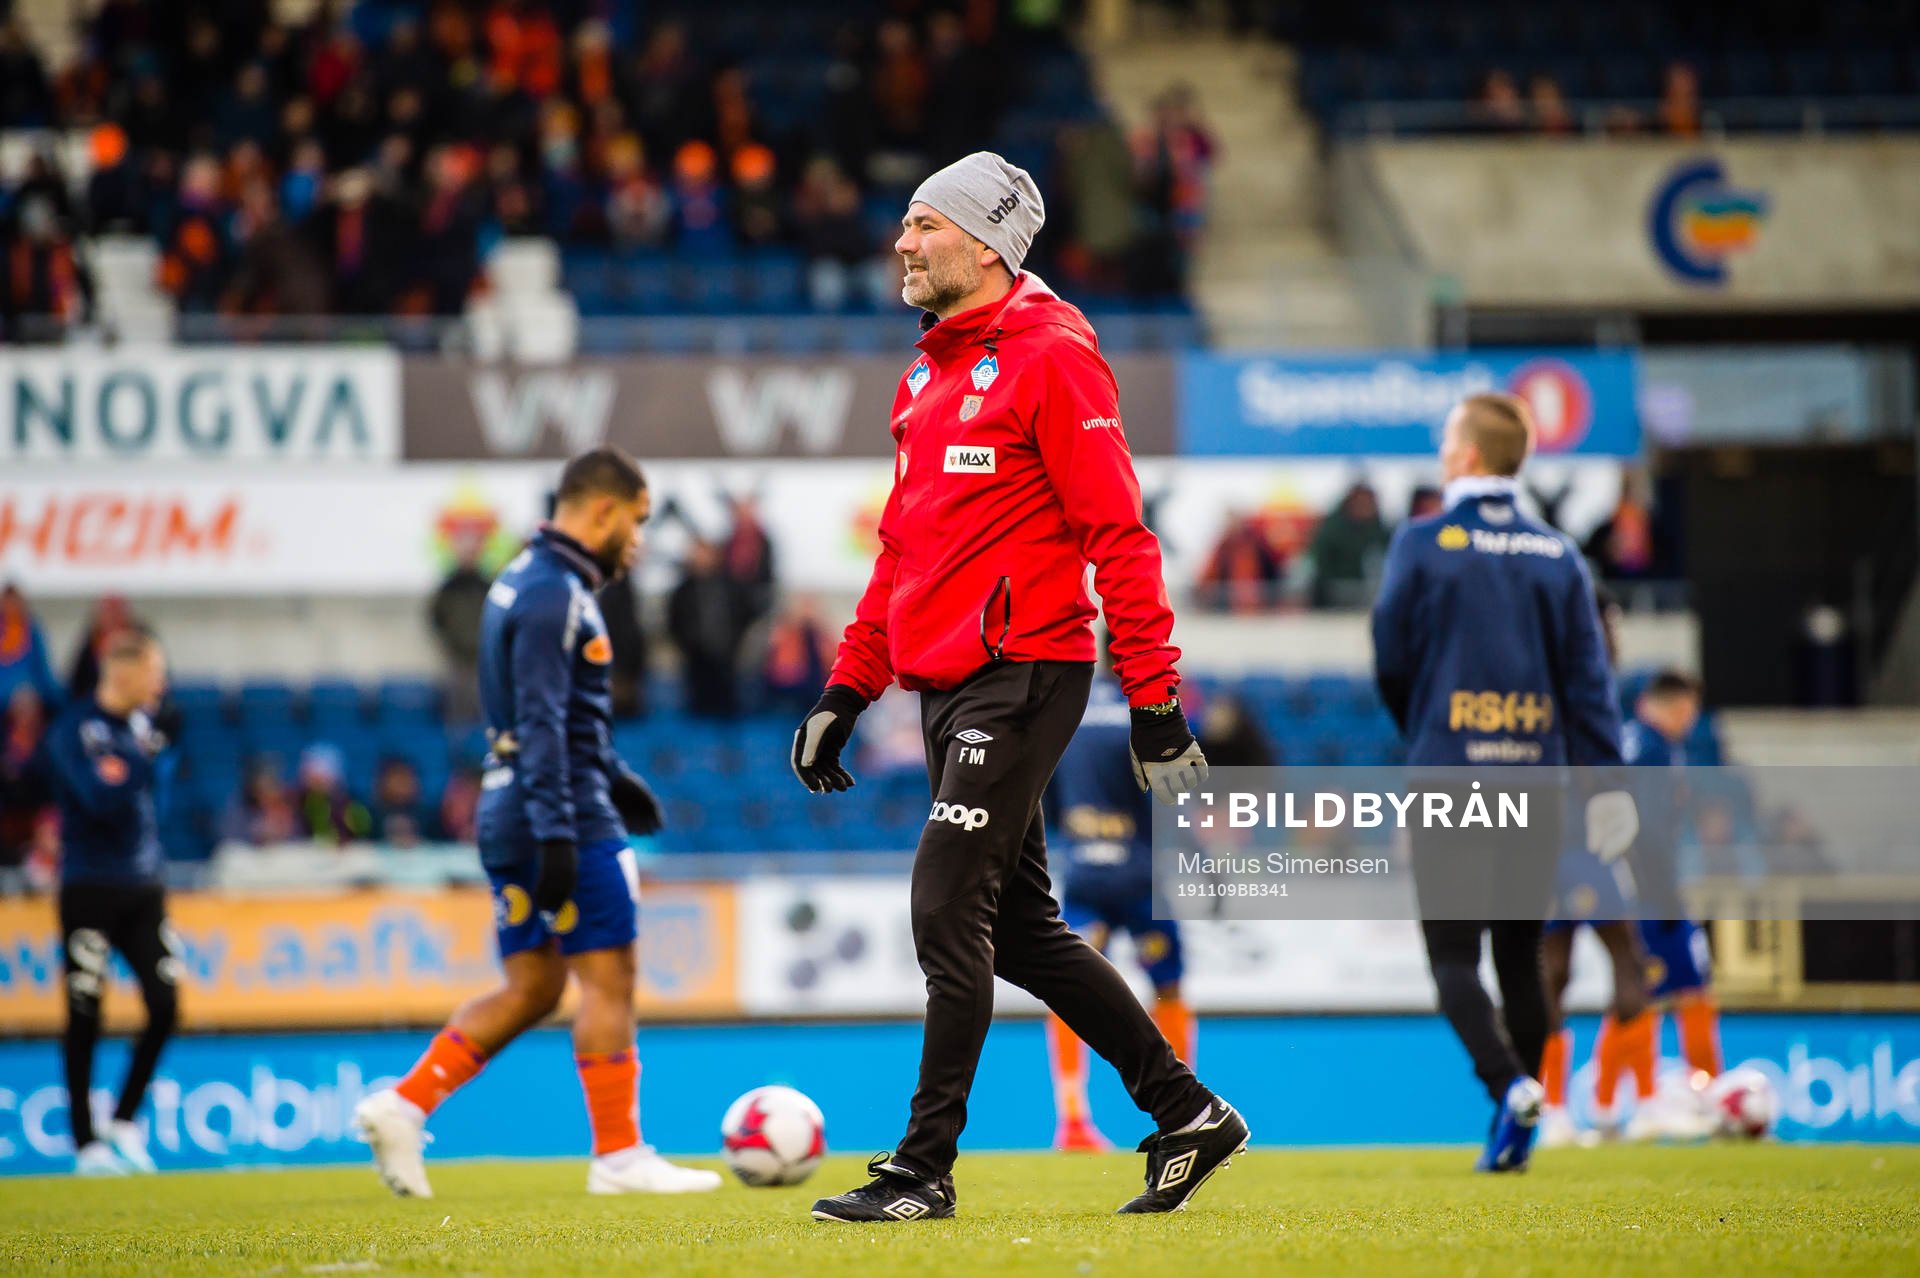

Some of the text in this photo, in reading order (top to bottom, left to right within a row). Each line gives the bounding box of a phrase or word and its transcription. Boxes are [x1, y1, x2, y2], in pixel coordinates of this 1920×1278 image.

[986, 188, 1020, 224] umbr
[14, 371, 371, 452] NOGVA
[1081, 415, 1119, 430] umbro
[959, 452, 991, 466] MAX
[958, 747, 986, 765] FM
